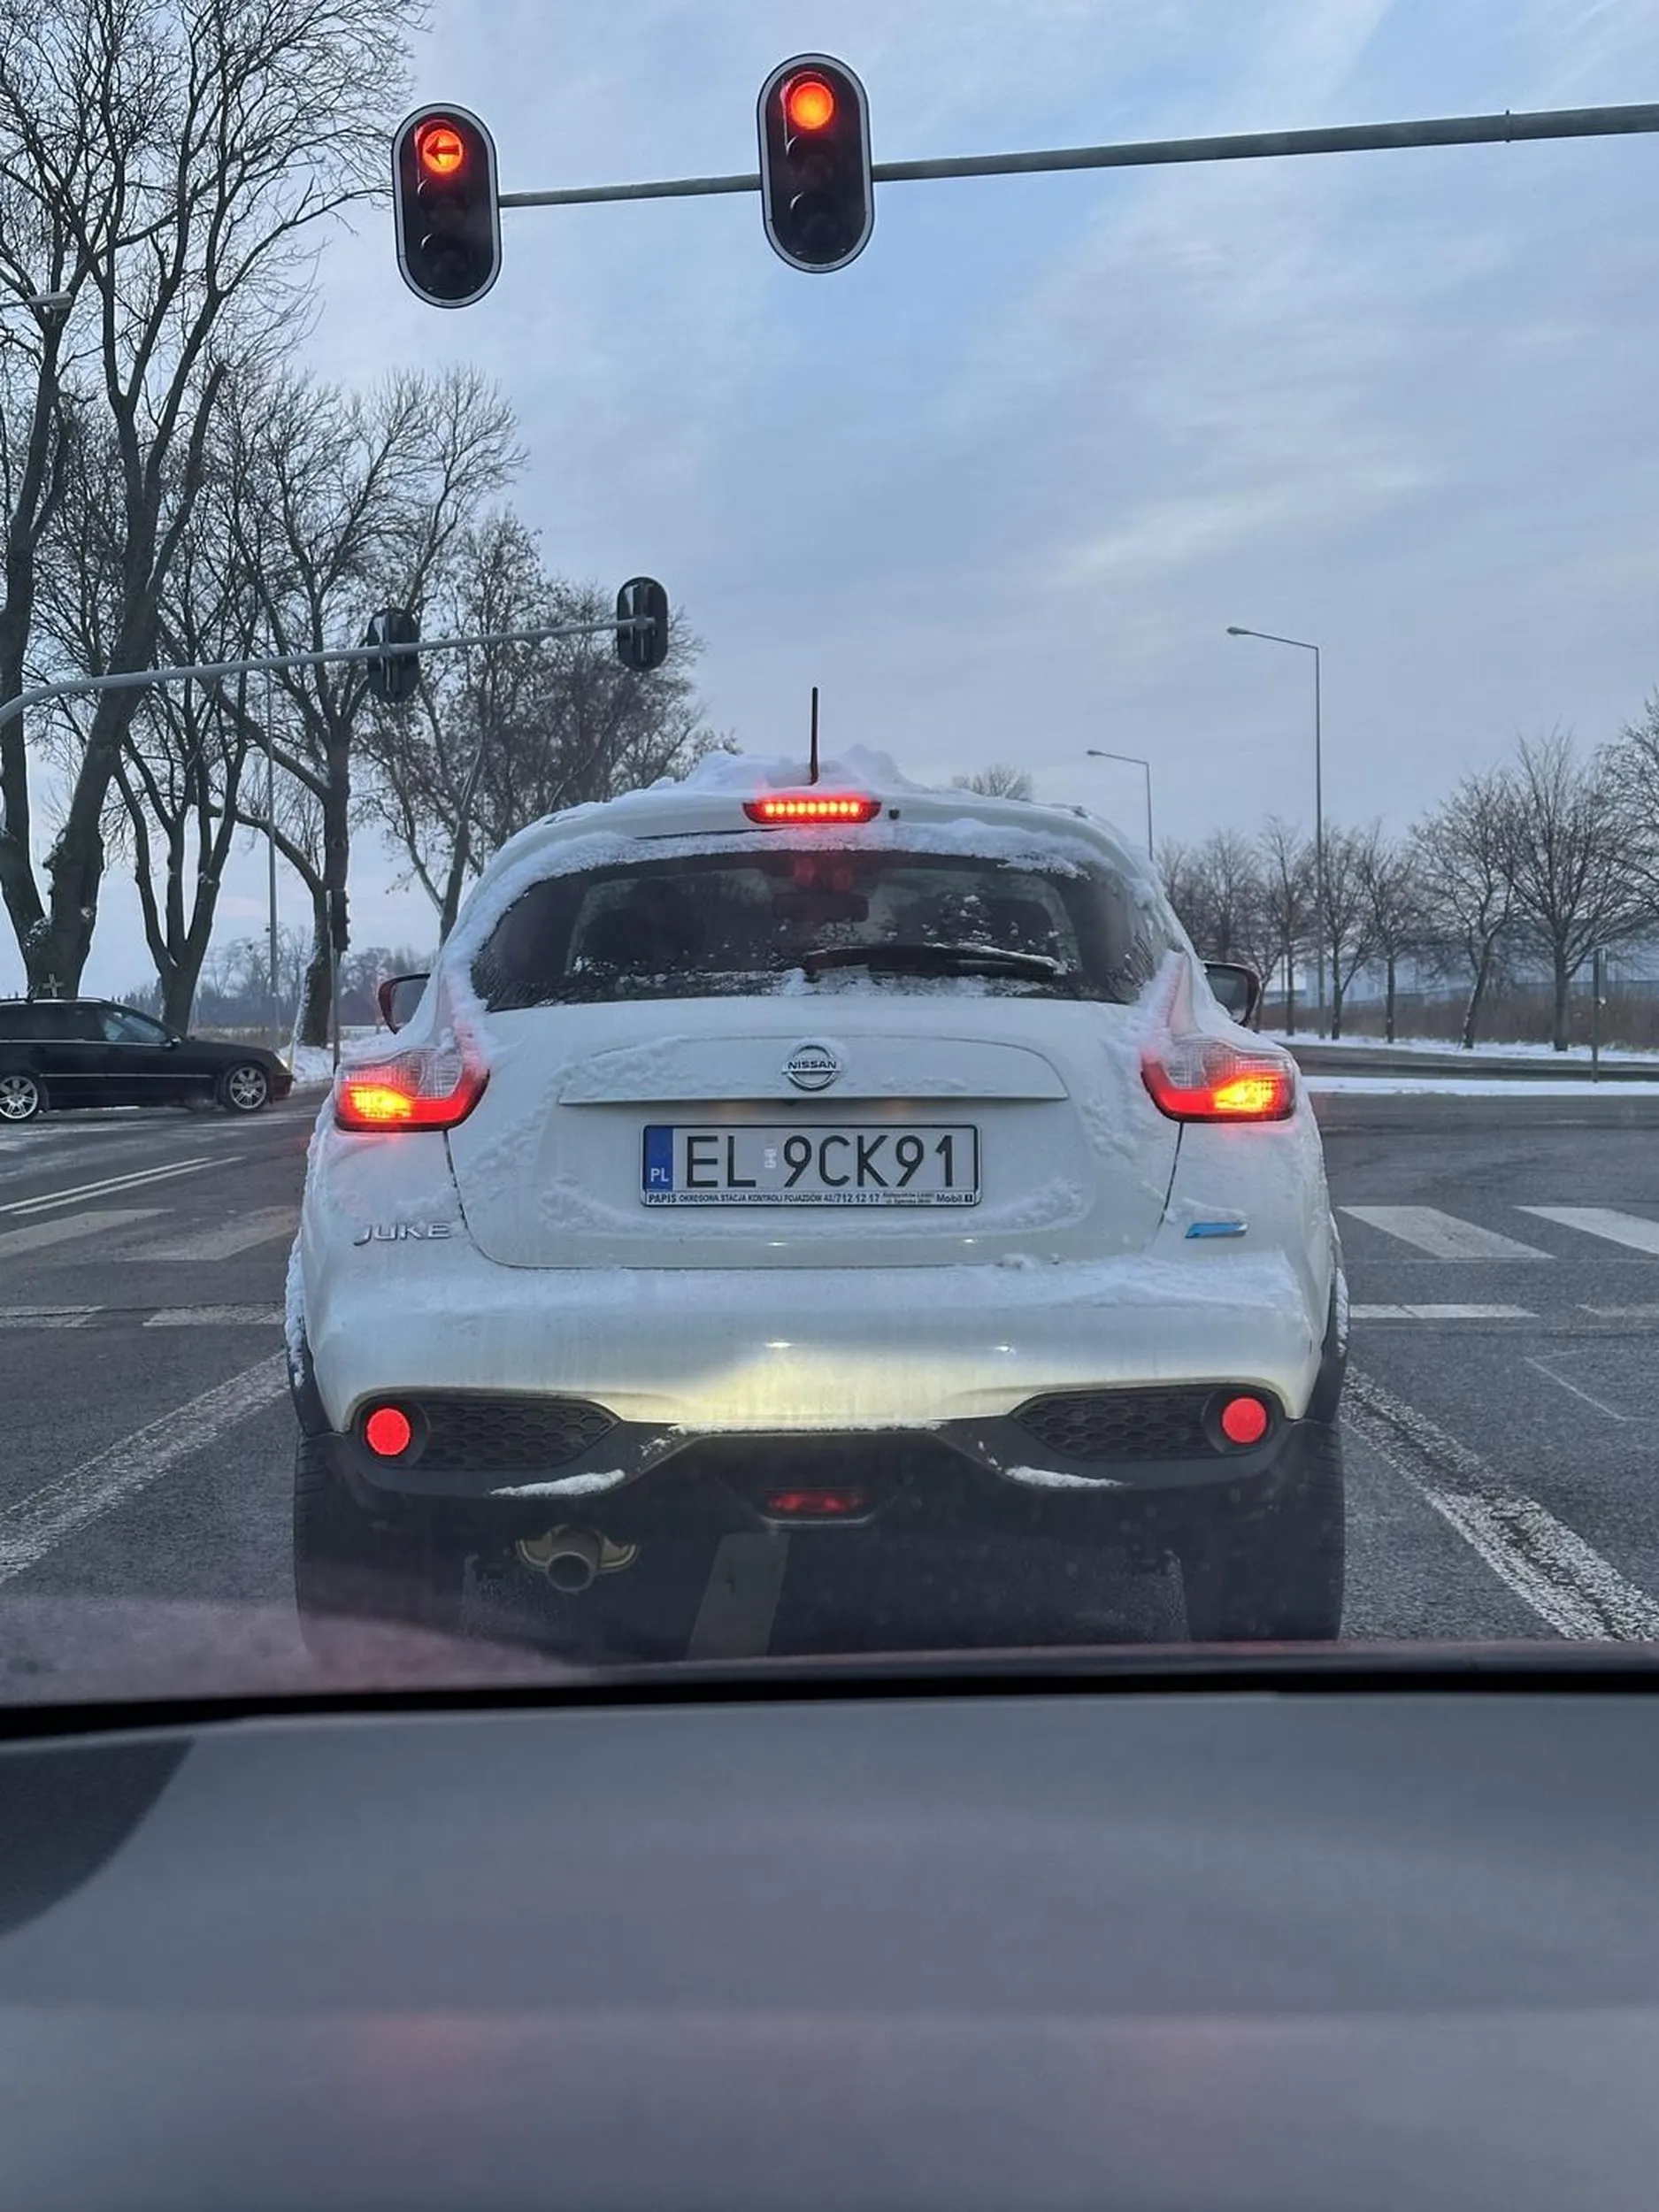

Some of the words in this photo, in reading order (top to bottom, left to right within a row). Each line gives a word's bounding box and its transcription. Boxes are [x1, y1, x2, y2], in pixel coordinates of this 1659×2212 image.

[787, 1061, 836, 1070] NISSAN
[686, 1135, 757, 1188] EL
[783, 1134, 953, 1188] 9CK91
[650, 1168, 669, 1182] PL
[353, 1223, 449, 1246] JUKE
